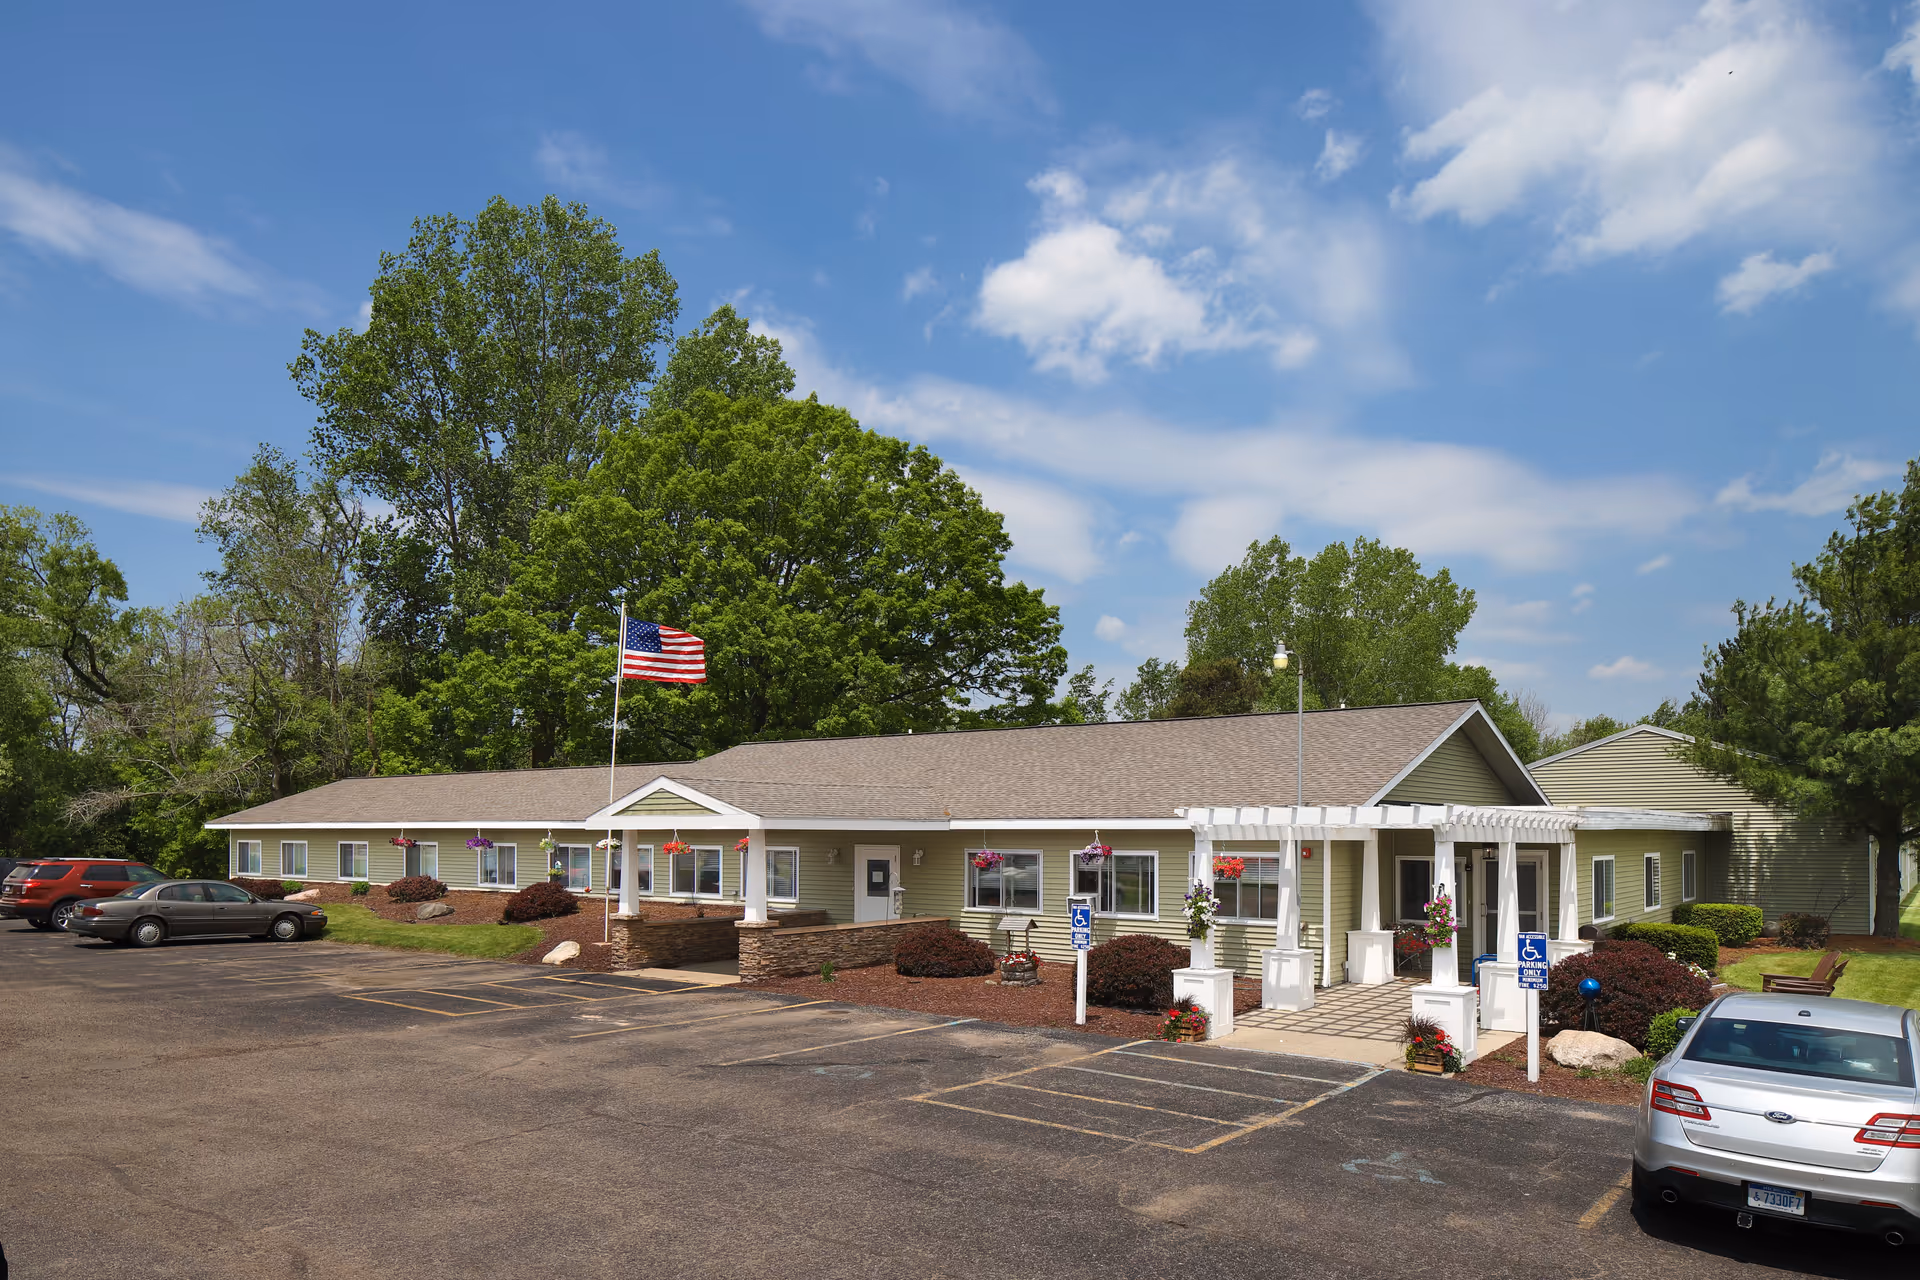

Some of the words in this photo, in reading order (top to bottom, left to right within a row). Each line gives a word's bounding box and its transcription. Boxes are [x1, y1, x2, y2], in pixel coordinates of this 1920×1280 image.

[1517, 961, 1547, 969] PARKING
[1772, 1112, 1789, 1120] Ford
[1763, 1191, 1802, 1210] 7330F7
